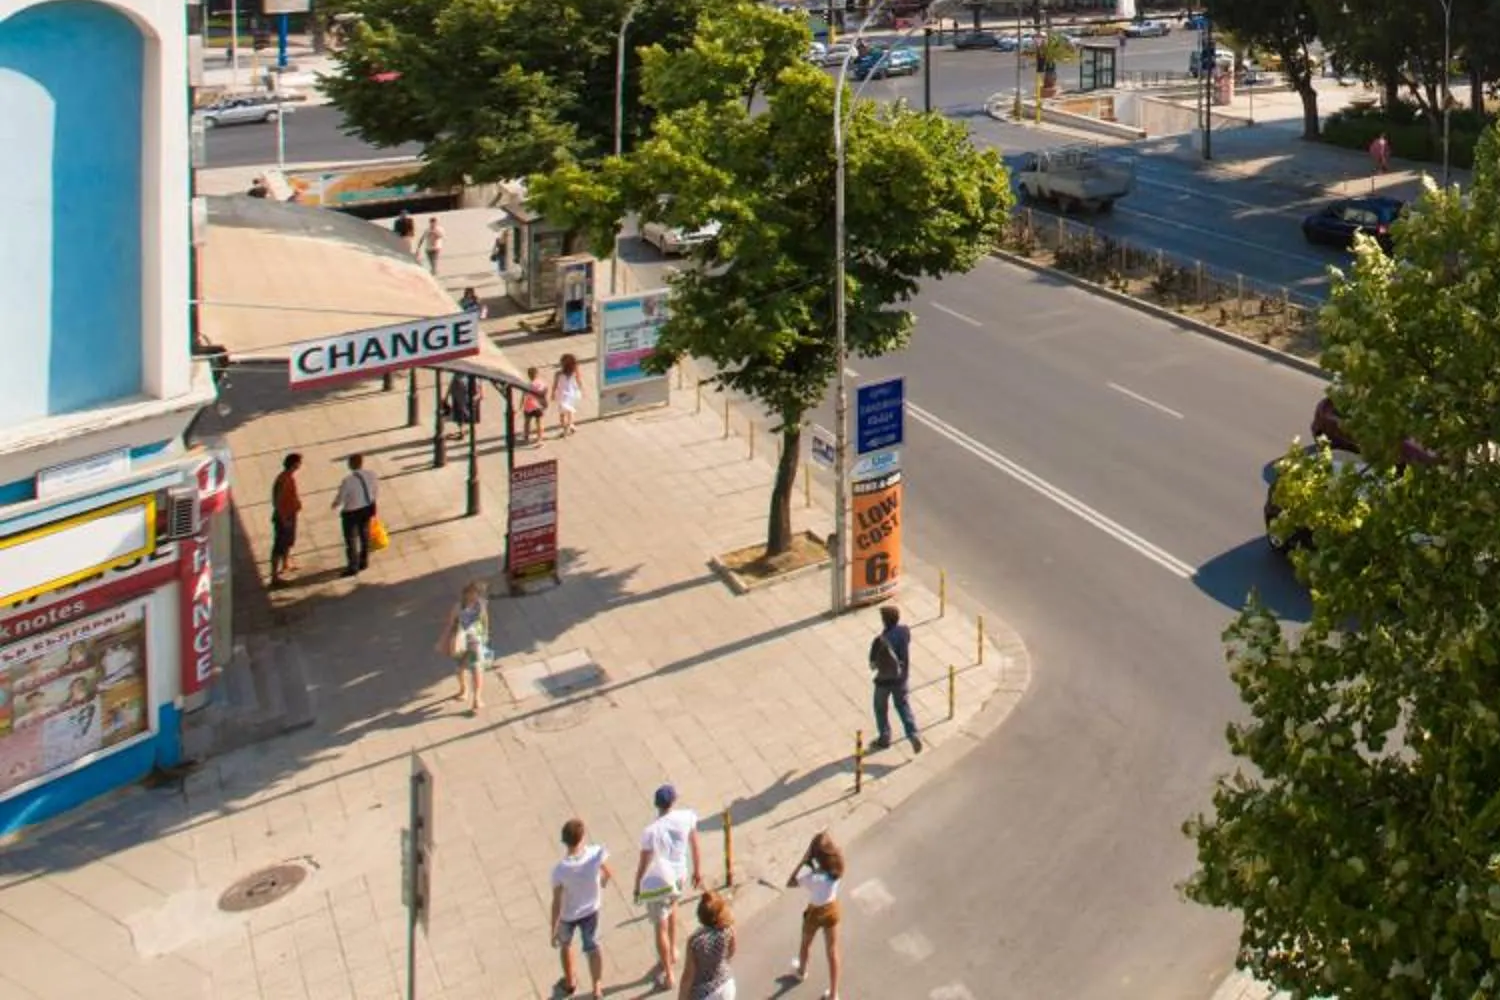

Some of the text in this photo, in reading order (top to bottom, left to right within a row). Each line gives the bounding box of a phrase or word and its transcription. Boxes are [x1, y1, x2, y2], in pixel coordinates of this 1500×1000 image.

[298, 320, 473, 375] CHANGE
[858, 490, 898, 530] LOW
[856, 512, 899, 551] COST
[864, 550, 890, 586] 6
[14, 600, 86, 635] notes
